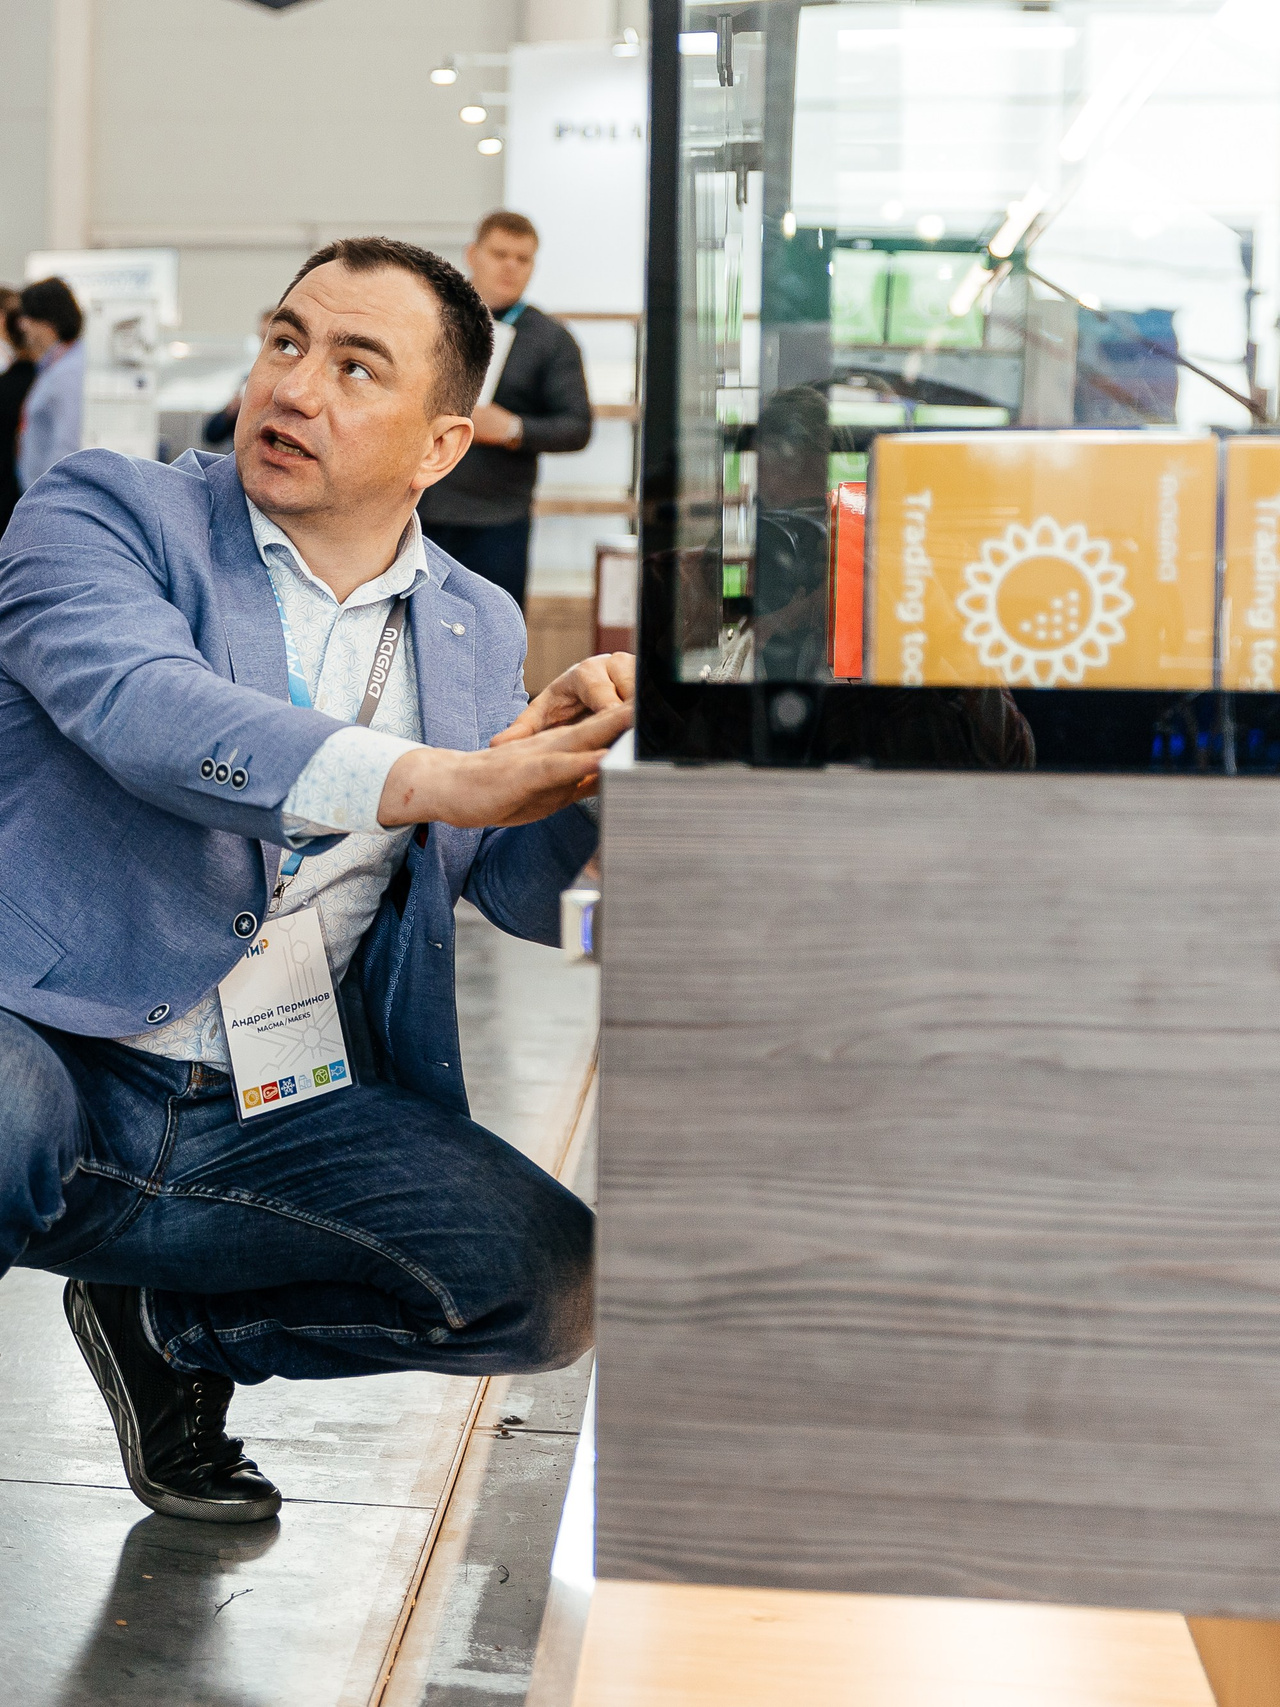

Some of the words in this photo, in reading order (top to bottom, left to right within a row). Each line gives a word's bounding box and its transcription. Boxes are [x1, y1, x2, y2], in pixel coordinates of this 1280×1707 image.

[895, 488, 933, 623] Trading
[231, 1008, 274, 1029] Андрей
[276, 992, 330, 1015] Перминов
